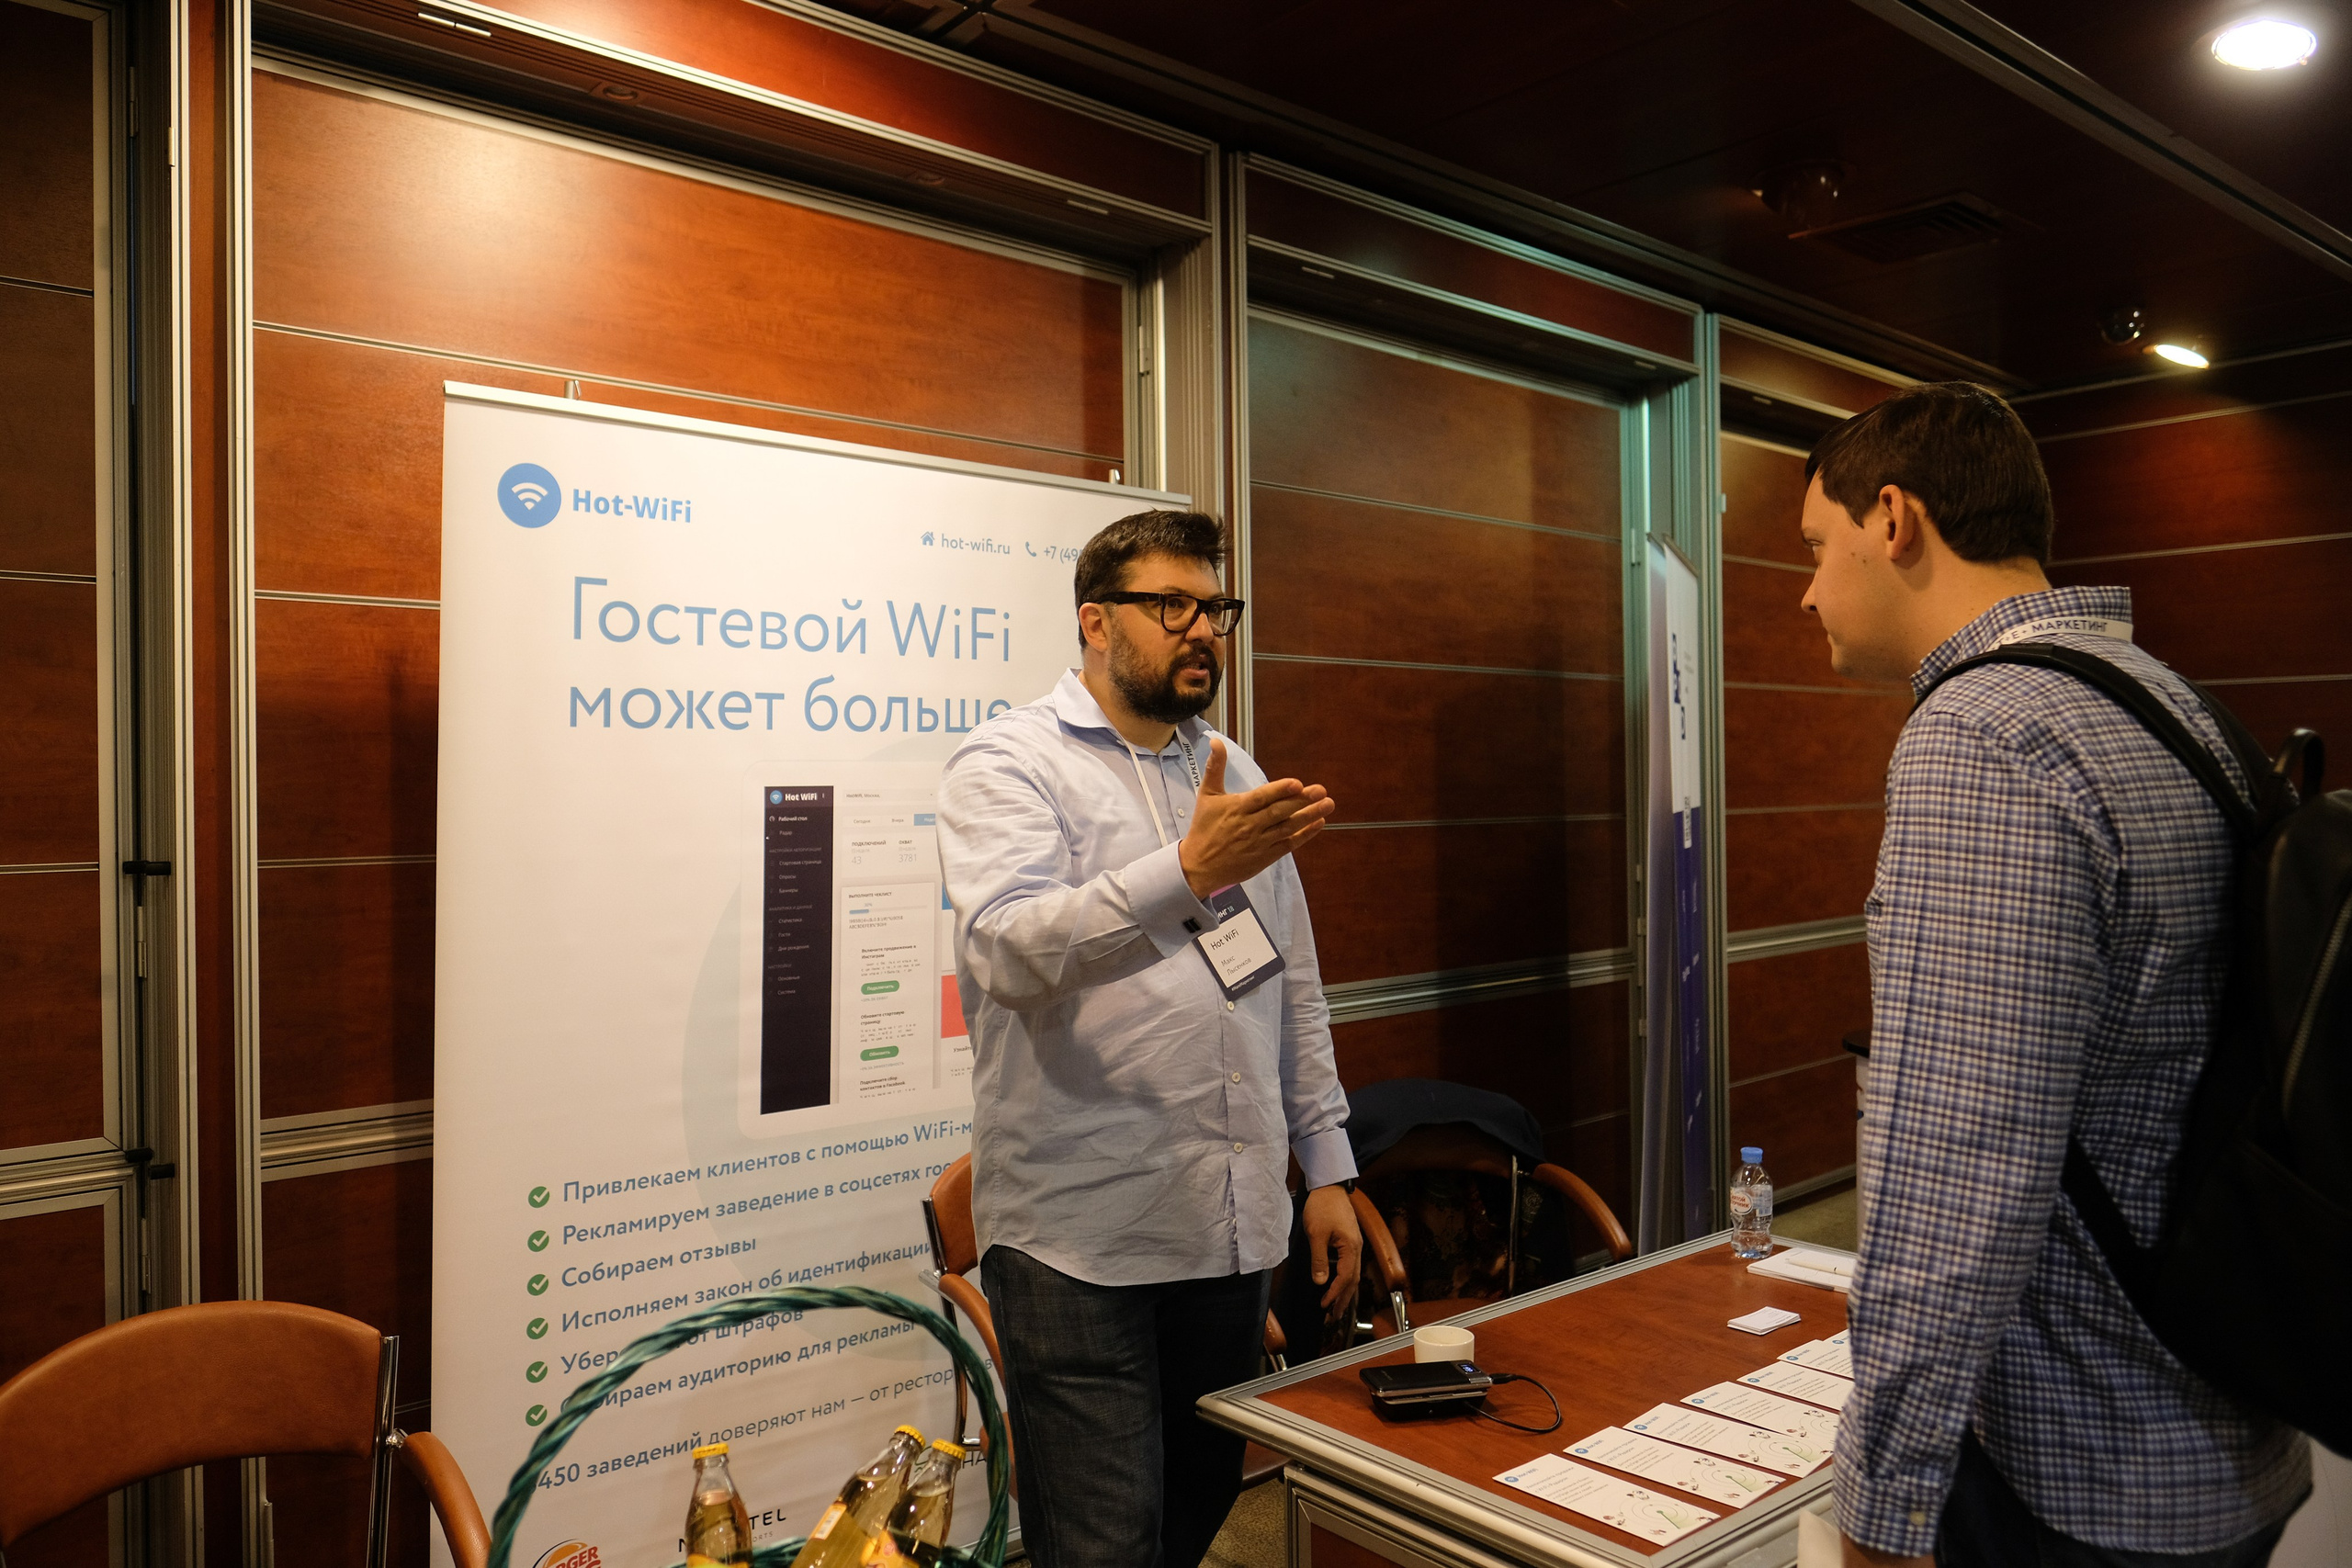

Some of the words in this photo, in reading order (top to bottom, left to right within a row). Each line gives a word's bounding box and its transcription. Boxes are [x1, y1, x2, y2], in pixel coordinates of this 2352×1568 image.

[572, 488, 691, 523] Hot-WiFi
[941, 533, 1011, 555] hot-wifi.ru
[1044, 546, 1057, 559] +7
[1059, 547, 1081, 564] (49
[573, 576, 866, 654] Гостевой
[886, 600, 1010, 661] WiFi
[2031, 619, 2108, 633] МАРКЕТИНГ
[570, 686, 785, 730] может
[1182, 742, 1201, 787] МАРКЕТИНГ
[785, 793, 799, 801] Hot
[800, 793, 818, 801] WiFi
[851, 855, 862, 864] 43
[899, 853, 917, 863] 3781
[1210, 939, 1225, 951] Hot
[1223, 929, 1239, 942] WiFi
[1220, 955, 1236, 967] Макс
[563, 1168, 700, 1203] Привлекаем
[707, 1151, 800, 1179] клиентов
[806, 1148, 816, 1161] с
[821, 1133, 909, 1158] помощью
[563, 1206, 709, 1245] Рекламируем
[715, 1187, 819, 1217] заведение
[824, 1184, 833, 1197] в
[839, 1168, 920, 1193] соцсетях
[925, 1162, 954, 1178] гос
[561, 1254, 673, 1287] Собираем
[679, 1238, 756, 1264] отзывы
[562, 1293, 688, 1332] Исполняем
[695, 1280, 752, 1303] закон
[758, 1269, 782, 1290] об
[560, 1350, 623, 1374] Убер
[678, 1350, 791, 1391] аудиторию
[797, 1340, 831, 1362] для
[837, 1322, 915, 1354] рекламы
[532, 1462, 581, 1492] 450
[587, 1432, 701, 1477] заведений
[707, 1408, 807, 1445] доверяют
[811, 1398, 845, 1418] нам
[869, 1385, 889, 1402] от
